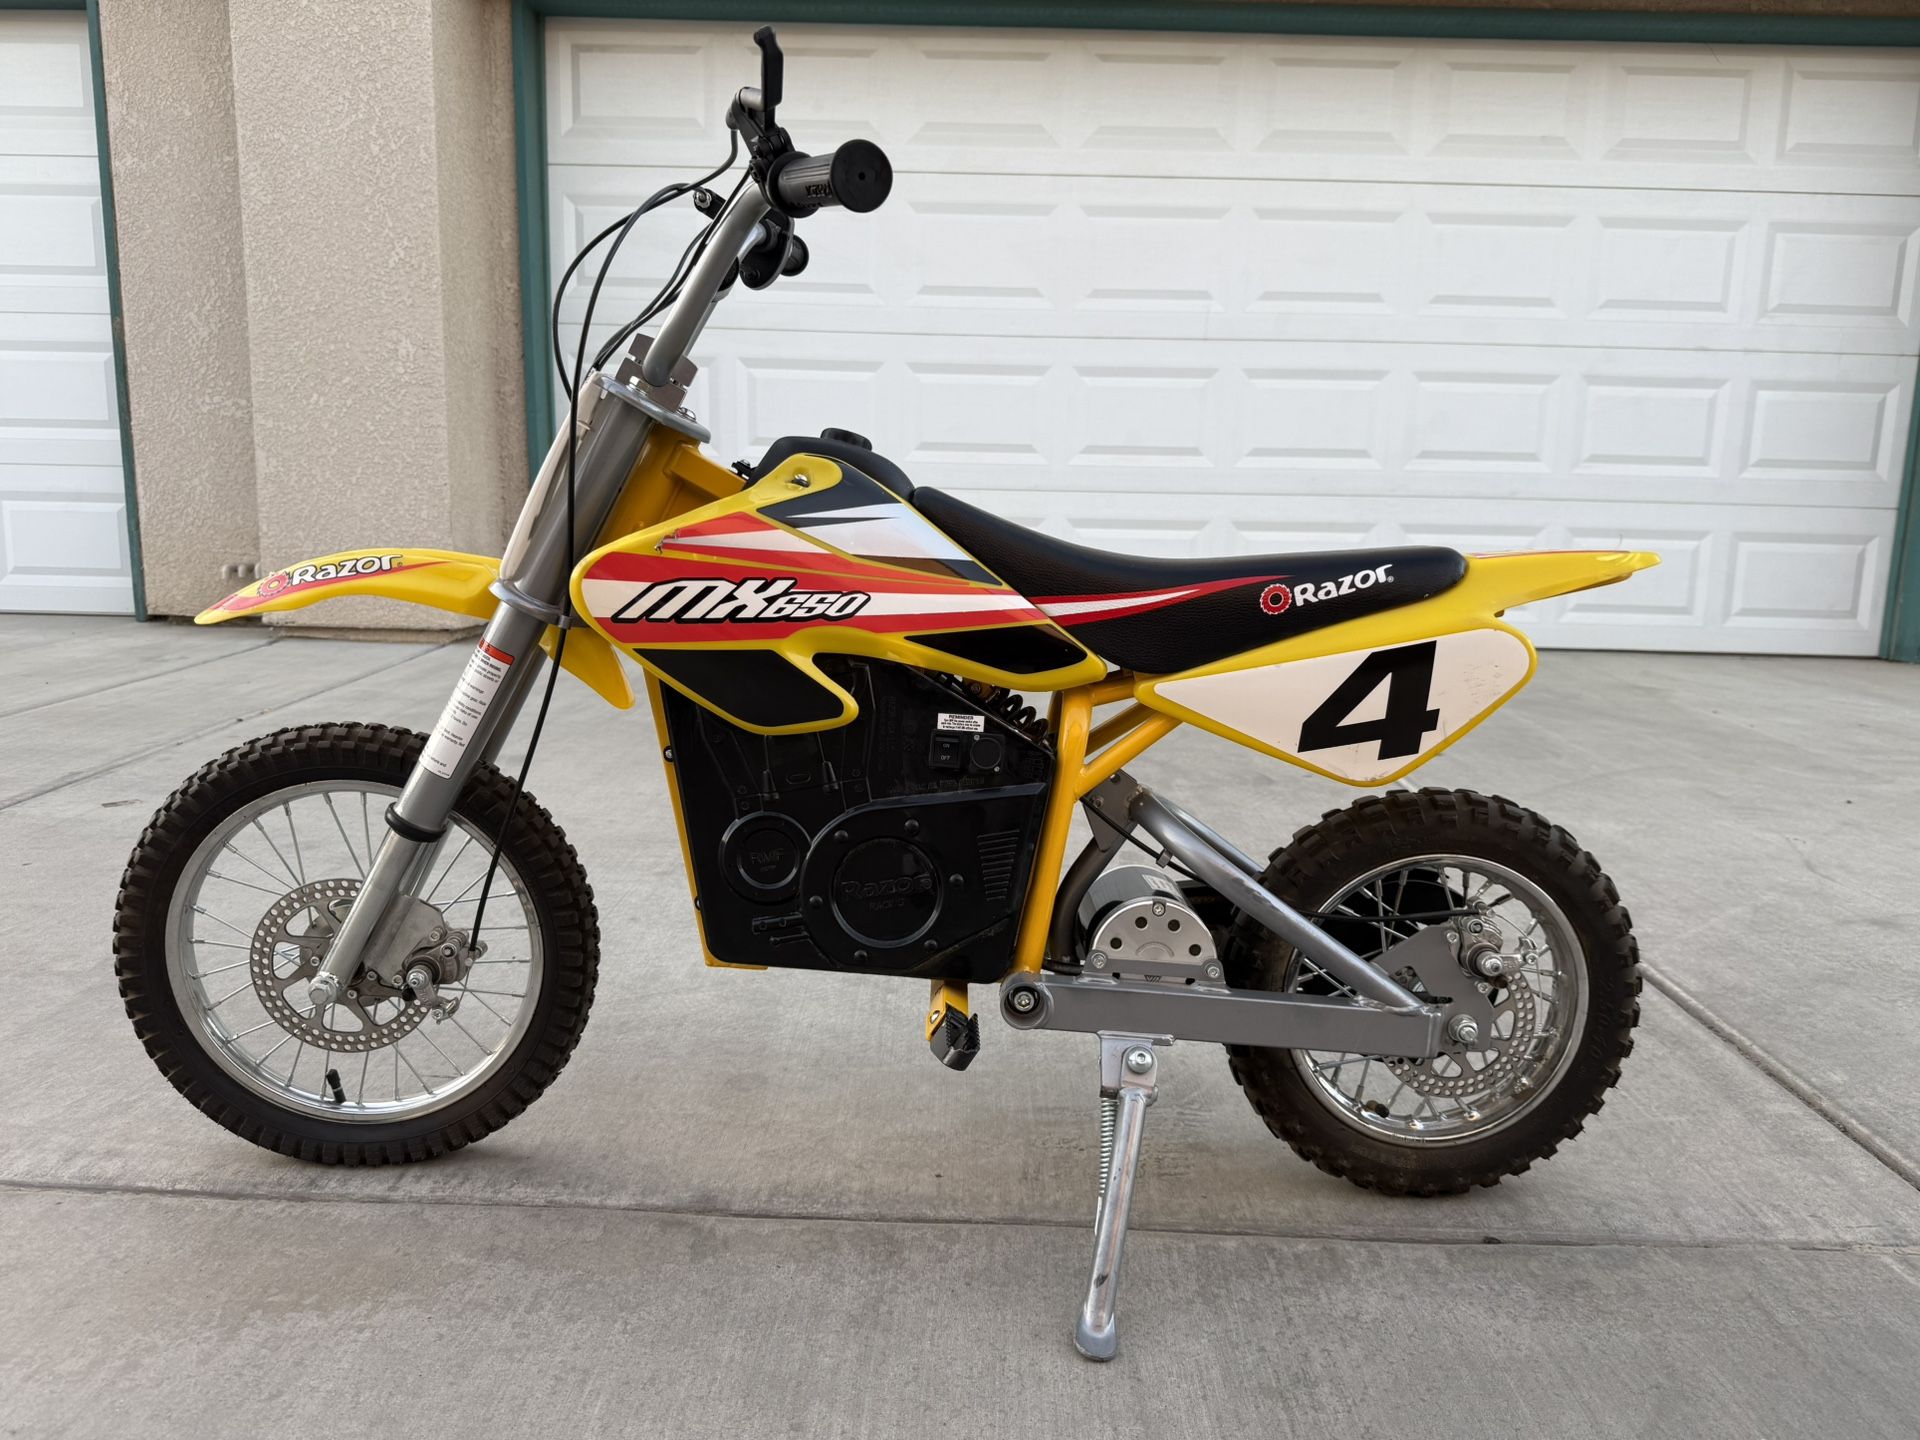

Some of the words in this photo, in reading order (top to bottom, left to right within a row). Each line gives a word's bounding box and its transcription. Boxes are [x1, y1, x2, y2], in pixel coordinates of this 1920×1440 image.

[290, 554, 403, 586] Razor
[1293, 563, 1393, 607] Razor
[1297, 640, 1440, 761] 4
